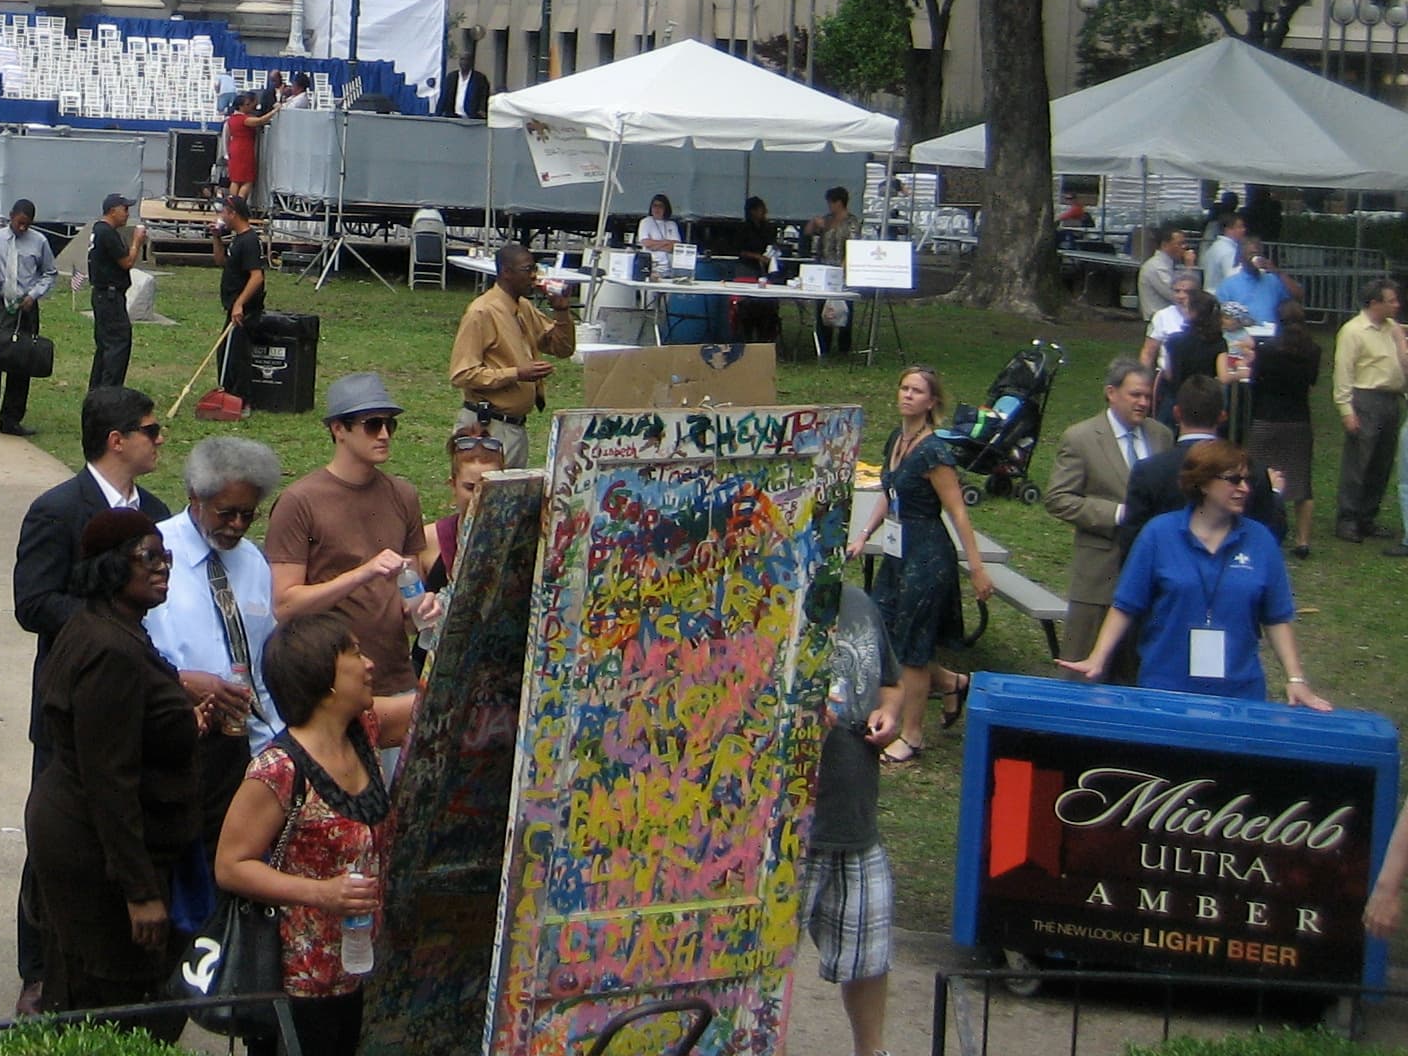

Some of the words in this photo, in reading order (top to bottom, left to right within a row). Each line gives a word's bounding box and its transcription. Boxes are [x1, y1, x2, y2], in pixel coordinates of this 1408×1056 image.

[1054, 768, 1355, 849] Michelob
[1139, 843, 1273, 883] ULTRA
[1086, 882, 1323, 934] AMBER
[1032, 919, 1057, 934] THE
[1057, 921, 1087, 937] NEW
[1087, 927, 1122, 941] LOOK
[1122, 932, 1141, 944] OF
[1143, 927, 1221, 956] LIGHT
[1226, 938, 1298, 966] BEER
